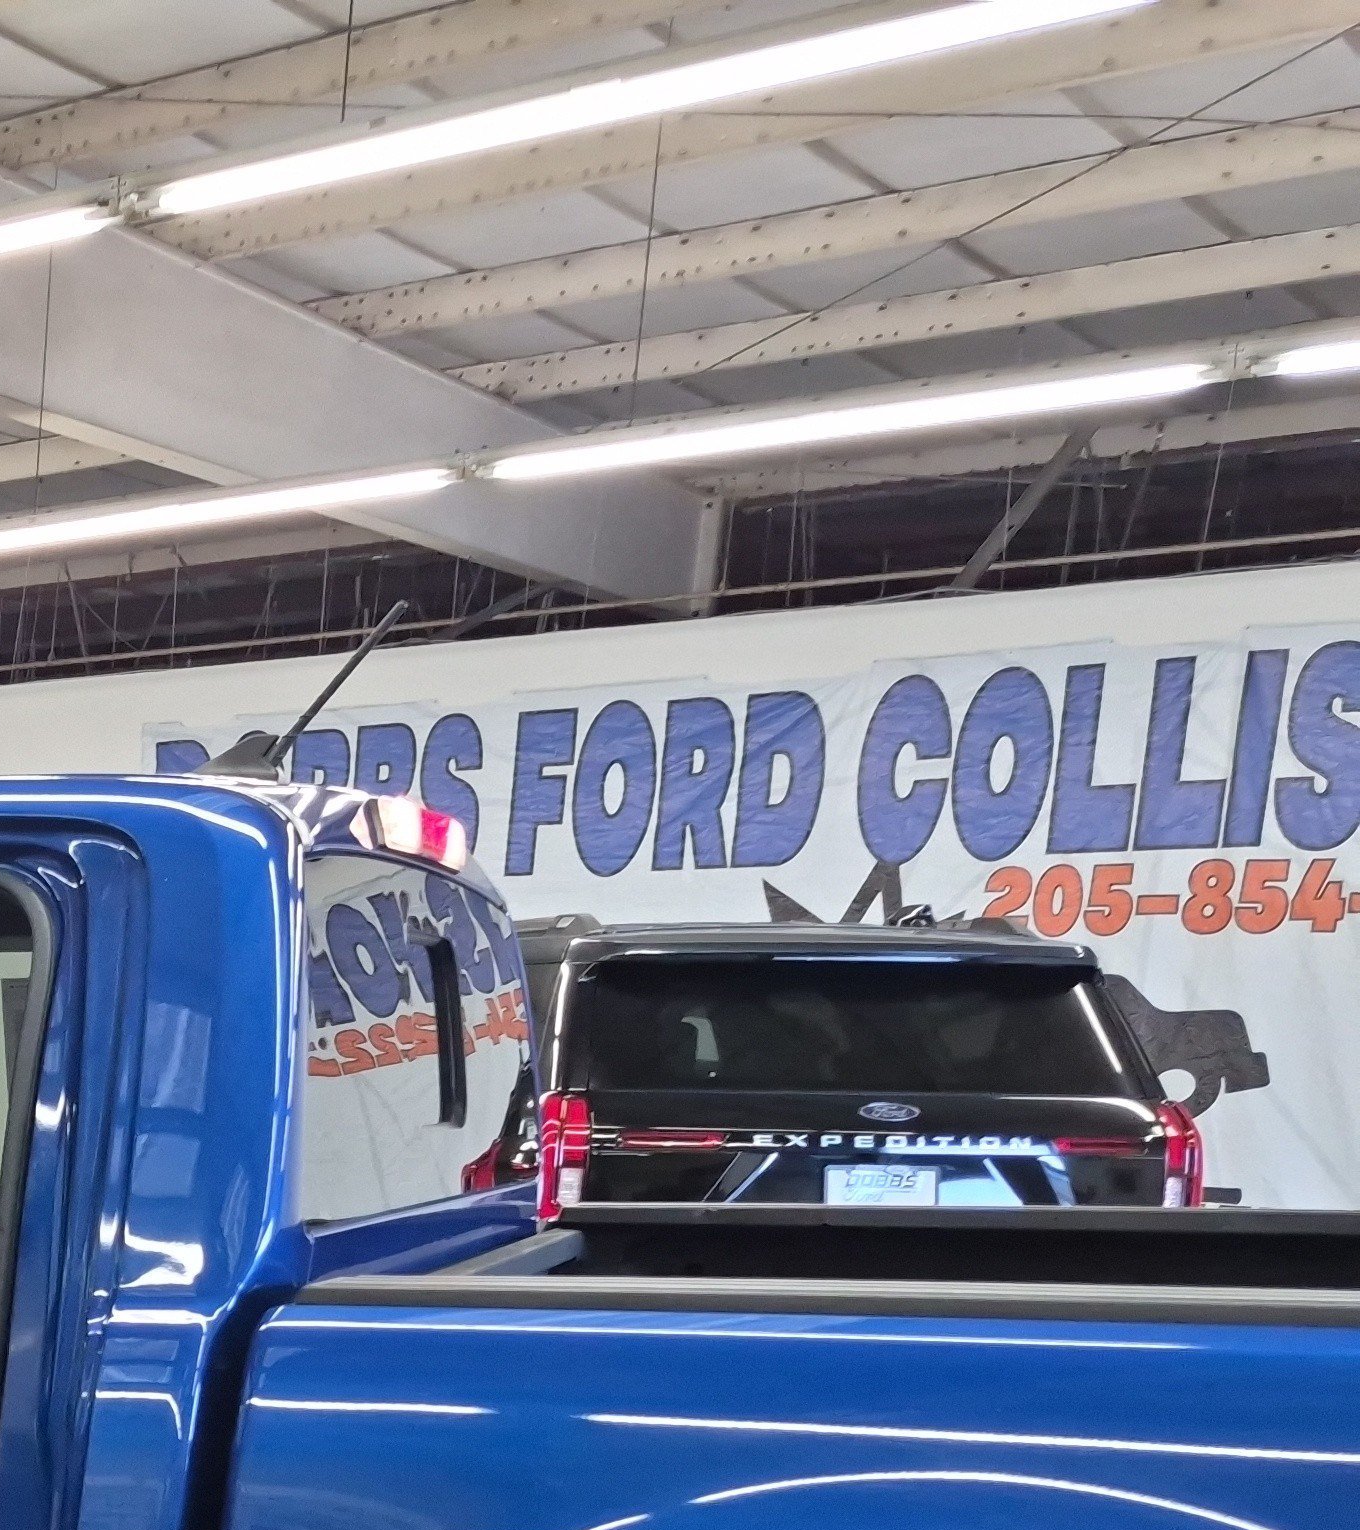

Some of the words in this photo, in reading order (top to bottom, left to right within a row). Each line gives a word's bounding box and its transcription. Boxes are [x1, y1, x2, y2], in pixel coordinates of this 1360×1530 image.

[504, 690, 826, 877] FORD
[857, 640, 1360, 863] COLLIS
[752, 1133, 1034, 1151] EXPEDITION
[844, 1173, 919, 1189] DOBBS
